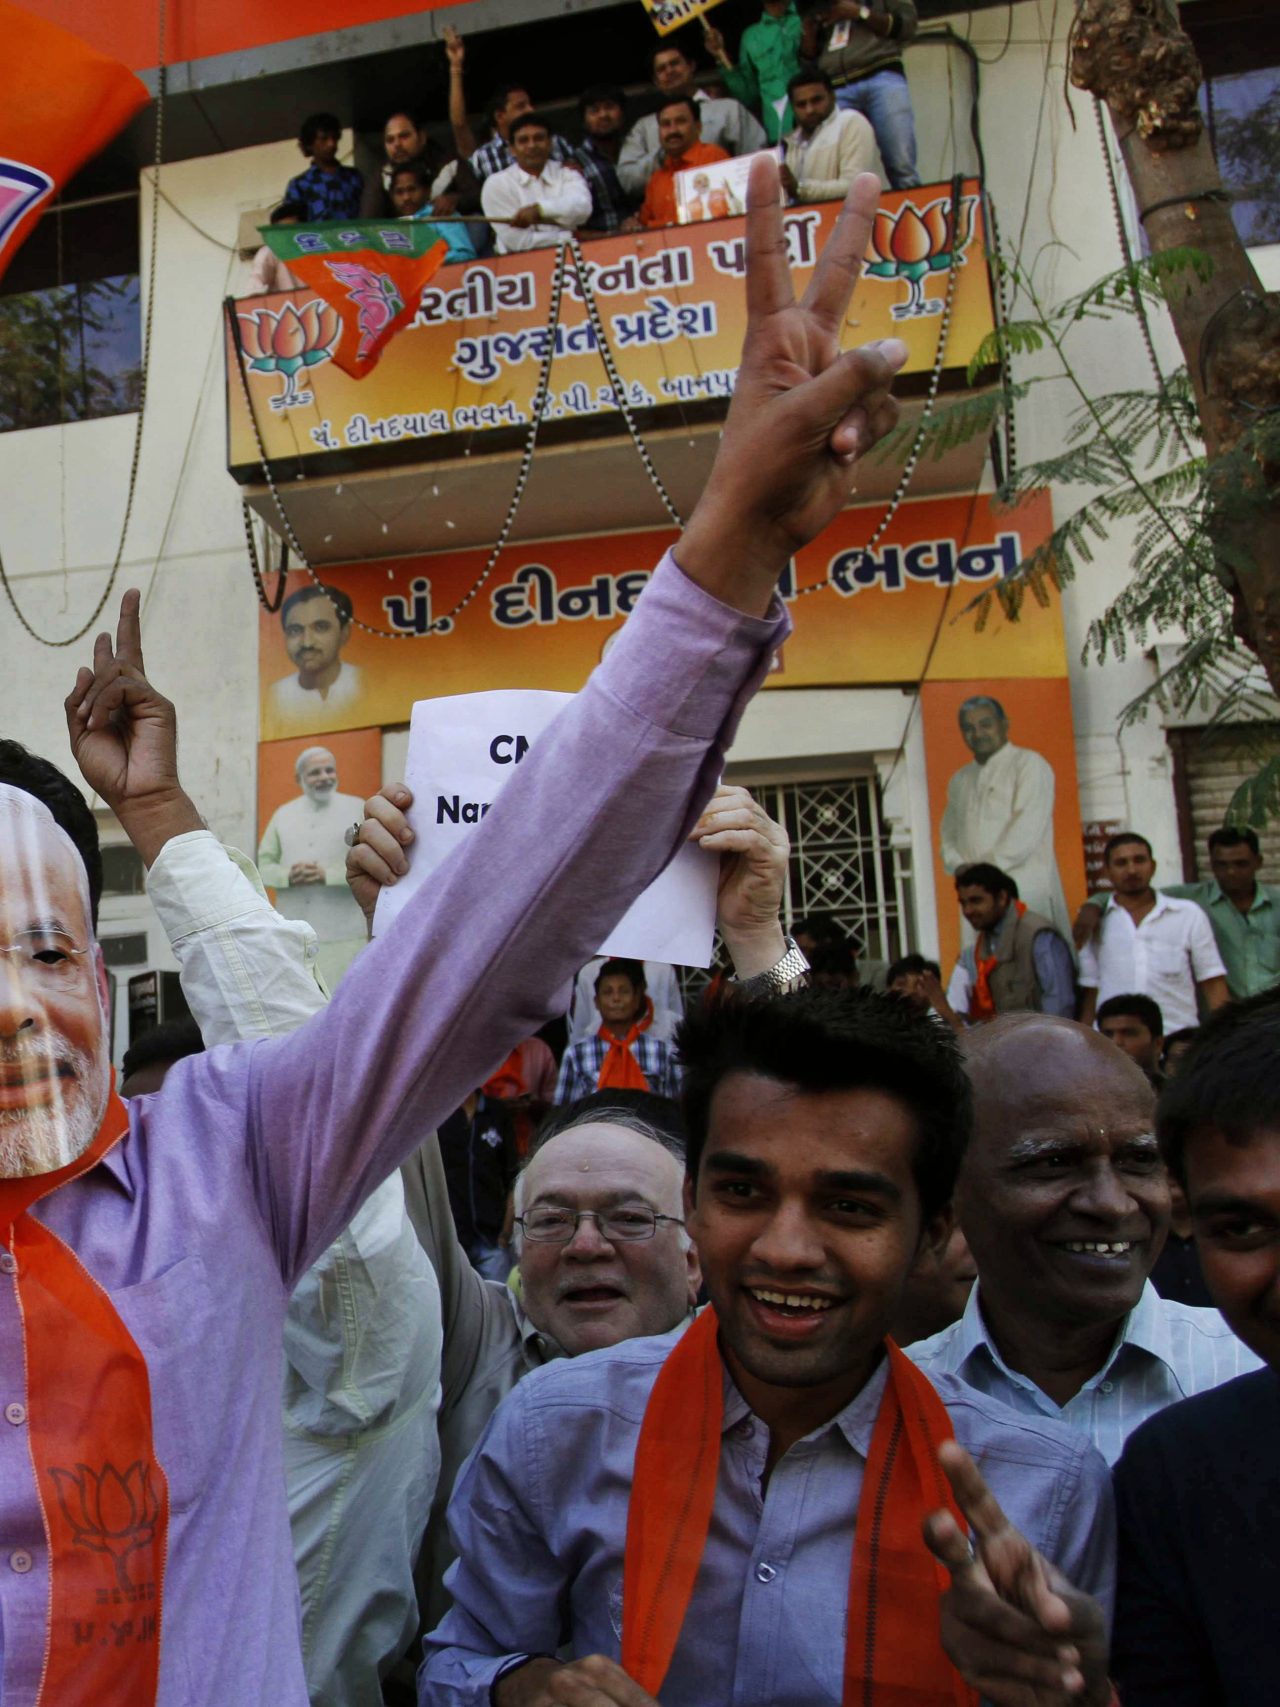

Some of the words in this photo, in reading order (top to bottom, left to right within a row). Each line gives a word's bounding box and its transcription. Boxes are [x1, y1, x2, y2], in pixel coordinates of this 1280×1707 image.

[414, 267, 534, 323] રતીય
[615, 300, 714, 344] પ્રદેશ
[348, 411, 447, 442] દીનદયાલ
[456, 402, 523, 428] ભવન,
[385, 579, 452, 634] પં.
[830, 532, 1020, 597] ભવન
